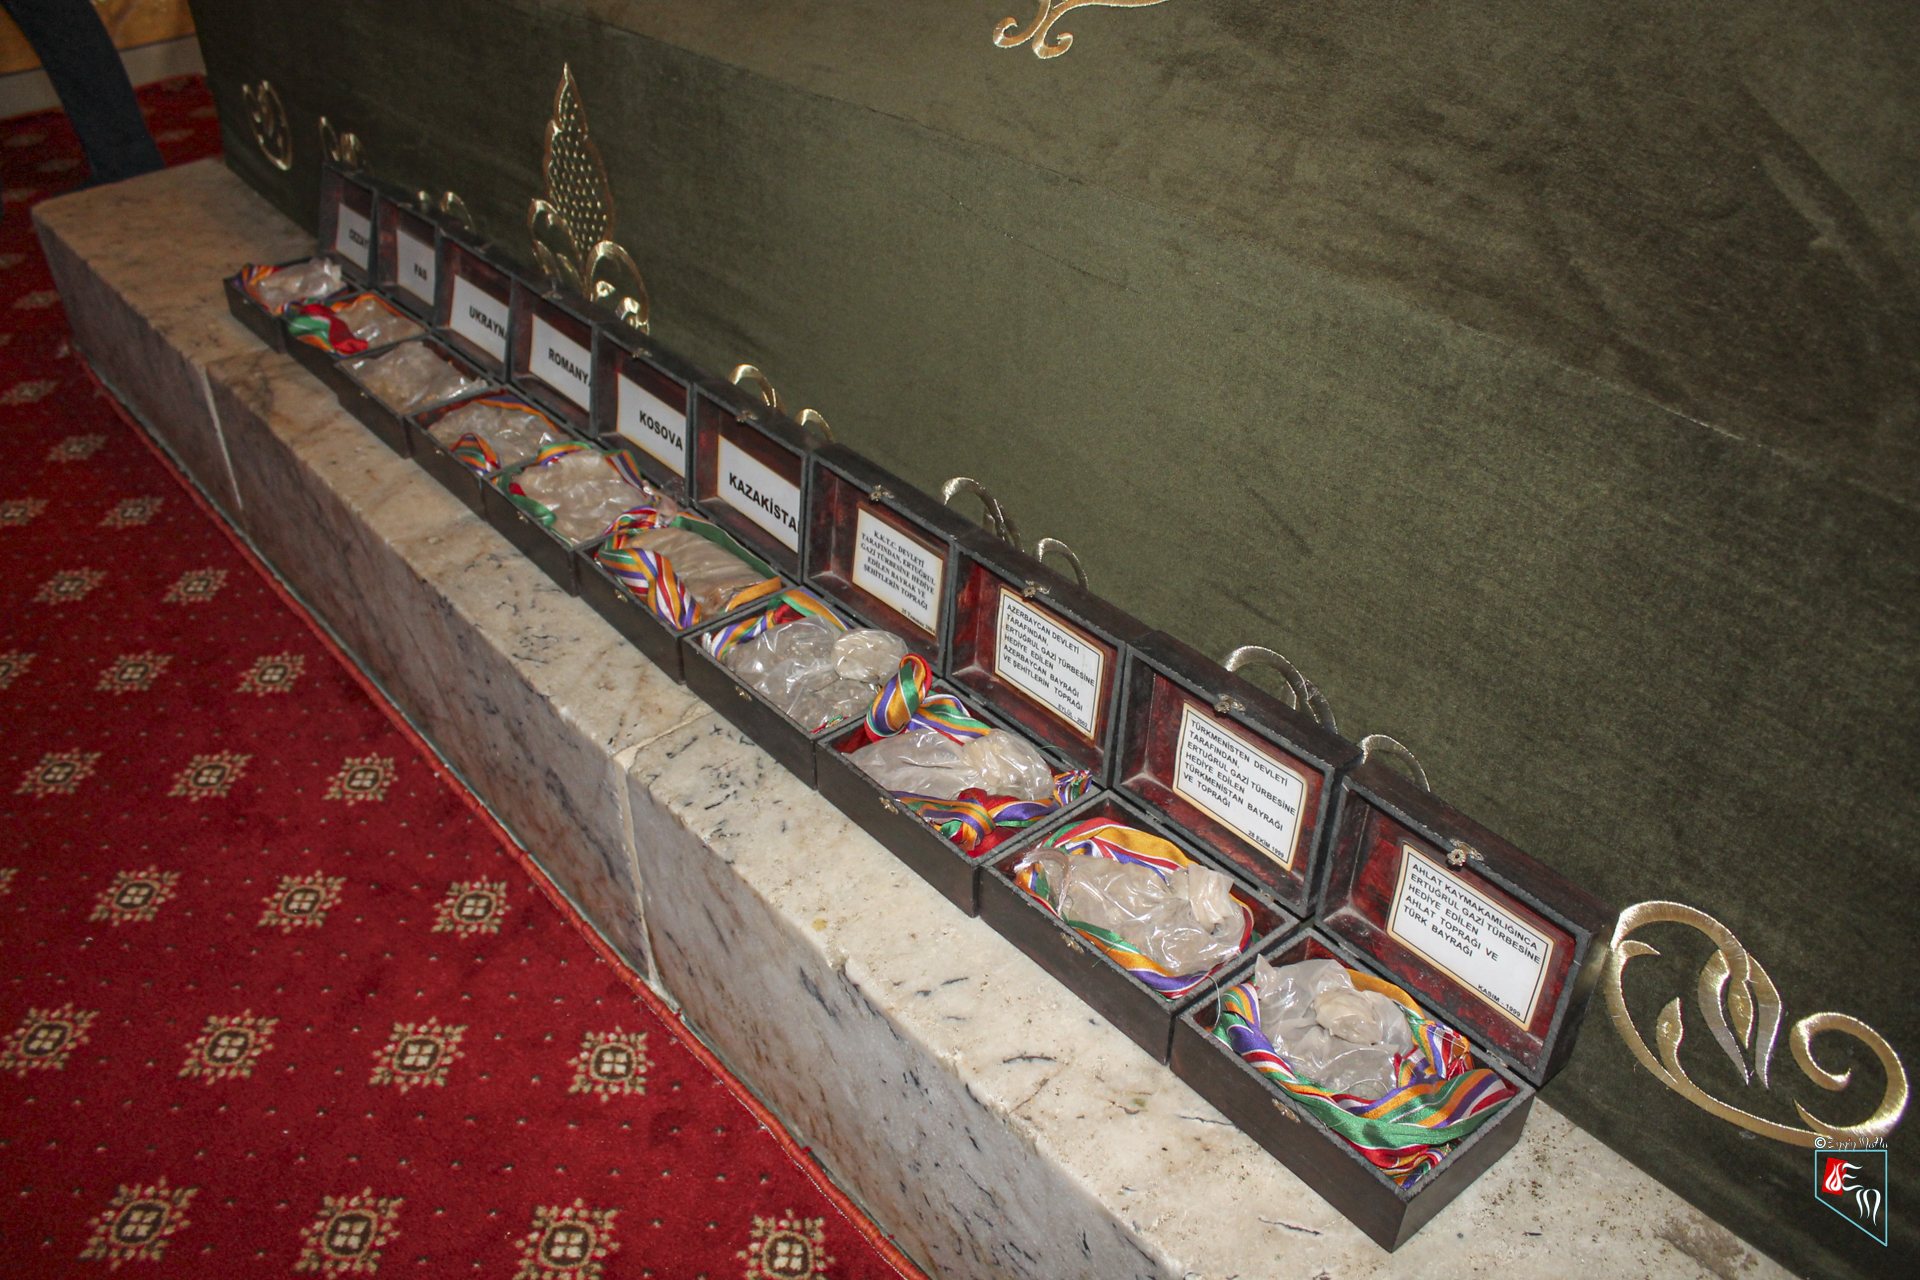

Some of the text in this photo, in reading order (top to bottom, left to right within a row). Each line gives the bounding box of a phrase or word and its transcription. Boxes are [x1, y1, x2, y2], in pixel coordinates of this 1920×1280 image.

[469, 305, 507, 340] UKRAYN
[549, 348, 591, 387] ROMANY
[639, 410, 683, 451] KOSOVA
[729, 472, 800, 533] KAZAKİSTA
[861, 543, 876, 556] GAZİ
[911, 574, 934, 595] HEDİYE
[868, 557, 926, 599] EDİLEN BAYRAK VE
[898, 546, 925, 568] DEVLETİ
[901, 588, 928, 610] TOPRAĞI
[1004, 634, 1054, 670] HEDİYE EDİLEN
[1006, 614, 1049, 646] TARAFINDAN,
[1007, 604, 1080, 655] AZERBAYCAN DEVLETİ
[1003, 645, 1080, 698] AZERBAYCAN BAYRAĞI
[1005, 624, 1095, 687] ERTUĞRUL GAZİ TÜRBESİNE
[1003, 653, 1083, 711] VE ŞEHİTLERİN TOPRAĞI
[1186, 753, 1245, 794] HEDİYE EDİLEN
[1189, 730, 1240, 769] TARAFINDAN,
[1190, 719, 1288, 787] TÜRKMENİSTEN DEVLETİ
[1183, 772, 1231, 808] VE TOPRAĞI
[1184, 762, 1283, 831] TÜRKMENİSTAN BAYRAĞI
[1187, 741, 1296, 816] ERTUĞRUL GAZİ TÜRBESİNE
[1256, 836, 1271, 849] EKİM
[1404, 905, 1473, 957] TÜRK BAYRAĞI
[1405, 895, 1499, 962] AHLAT TOPRAĞI VE
[1408, 884, 1479, 935] HEDİYE EDİLEN
[1411, 873, 1541, 965] ERTUĞRUL GAZİ TÜRBESİNE
[1412, 863, 1538, 951] AHLAT KAYMAKAMLIĞINCA
[1478, 984, 1500, 1002] KASIM
[1505, 1003, 1521, 1017] 1999
